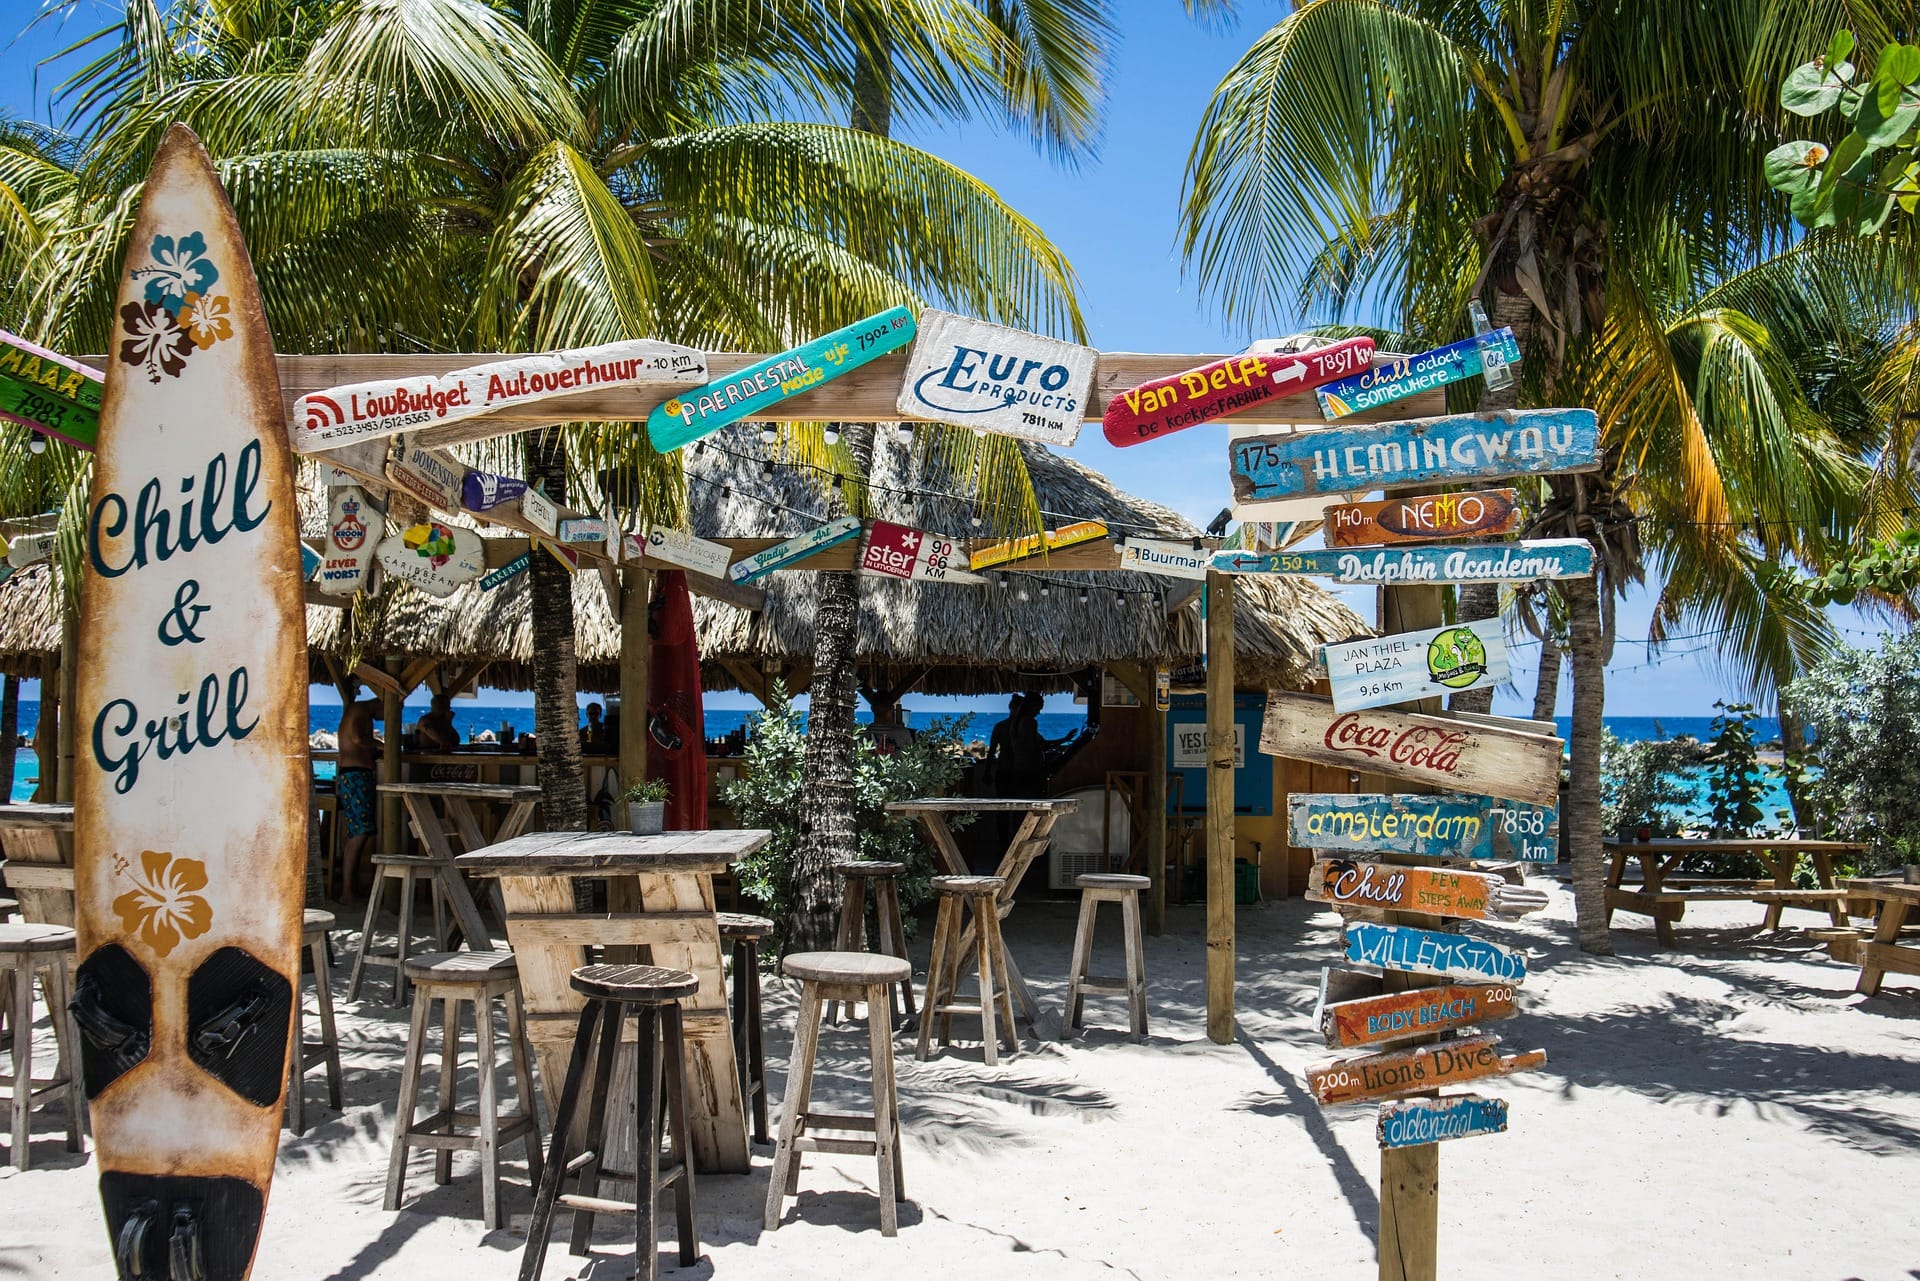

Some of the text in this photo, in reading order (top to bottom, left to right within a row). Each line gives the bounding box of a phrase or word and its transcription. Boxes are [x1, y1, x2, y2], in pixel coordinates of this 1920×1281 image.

[856, 323, 890, 352] 7902
[487, 358, 643, 401] Autoverhuur
[672, 354, 691, 368] km
[937, 345, 1070, 393] Euro
[1123, 345, 1375, 416] Van Delft 7897 km
[680, 353, 811, 427] PAERDESTAL
[978, 382, 1078, 413] PRODUCTS
[14, 388, 68, 428] 7983
[1021, 411, 1064, 431] 7811 KM
[1137, 421, 1159, 438] De
[1312, 425, 1574, 480] HEMINGWAY
[89, 438, 272, 578] Chill
[1401, 494, 1485, 529] NEMO
[335, 530, 363, 538] KROON
[754, 528, 831, 567] Gladys Art
[325, 558, 358, 569] LEVER
[384, 555, 455, 587] CARIBBEAN
[868, 540, 952, 570] ster 90
[928, 553, 949, 570] 66
[1270, 556, 1302, 572] 250
[1338, 551, 1437, 584] Dolphin
[1443, 550, 1563, 578] Academy
[323, 569, 361, 581] WORST
[401, 569, 433, 586] LEGACY
[484, 570, 515, 588] BAKER
[925, 566, 946, 580] KM
[157, 579, 211, 646] &
[1343, 641, 1410, 663] JAN THIEL
[1355, 657, 1403, 675] PLAZA
[1359, 680, 1404, 697] 9,6 Km
[92, 666, 260, 795] Grill
[1179, 733, 1202, 749] YES
[1307, 807, 1545, 841] amsterdam 7858
[1522, 840, 1548, 860] km
[1335, 866, 1461, 902] Chill FEW
[1418, 891, 1486, 910] STEPS AWAY
[1357, 930, 1515, 979] WILLEMSTAD
[1368, 1009, 1415, 1034] BODY
[1418, 998, 1476, 1025] BEACH
[1361, 1057, 1426, 1091] Lions
[1432, 1046, 1493, 1077] Dive
[1390, 1107, 1474, 1144] oldenzaal
